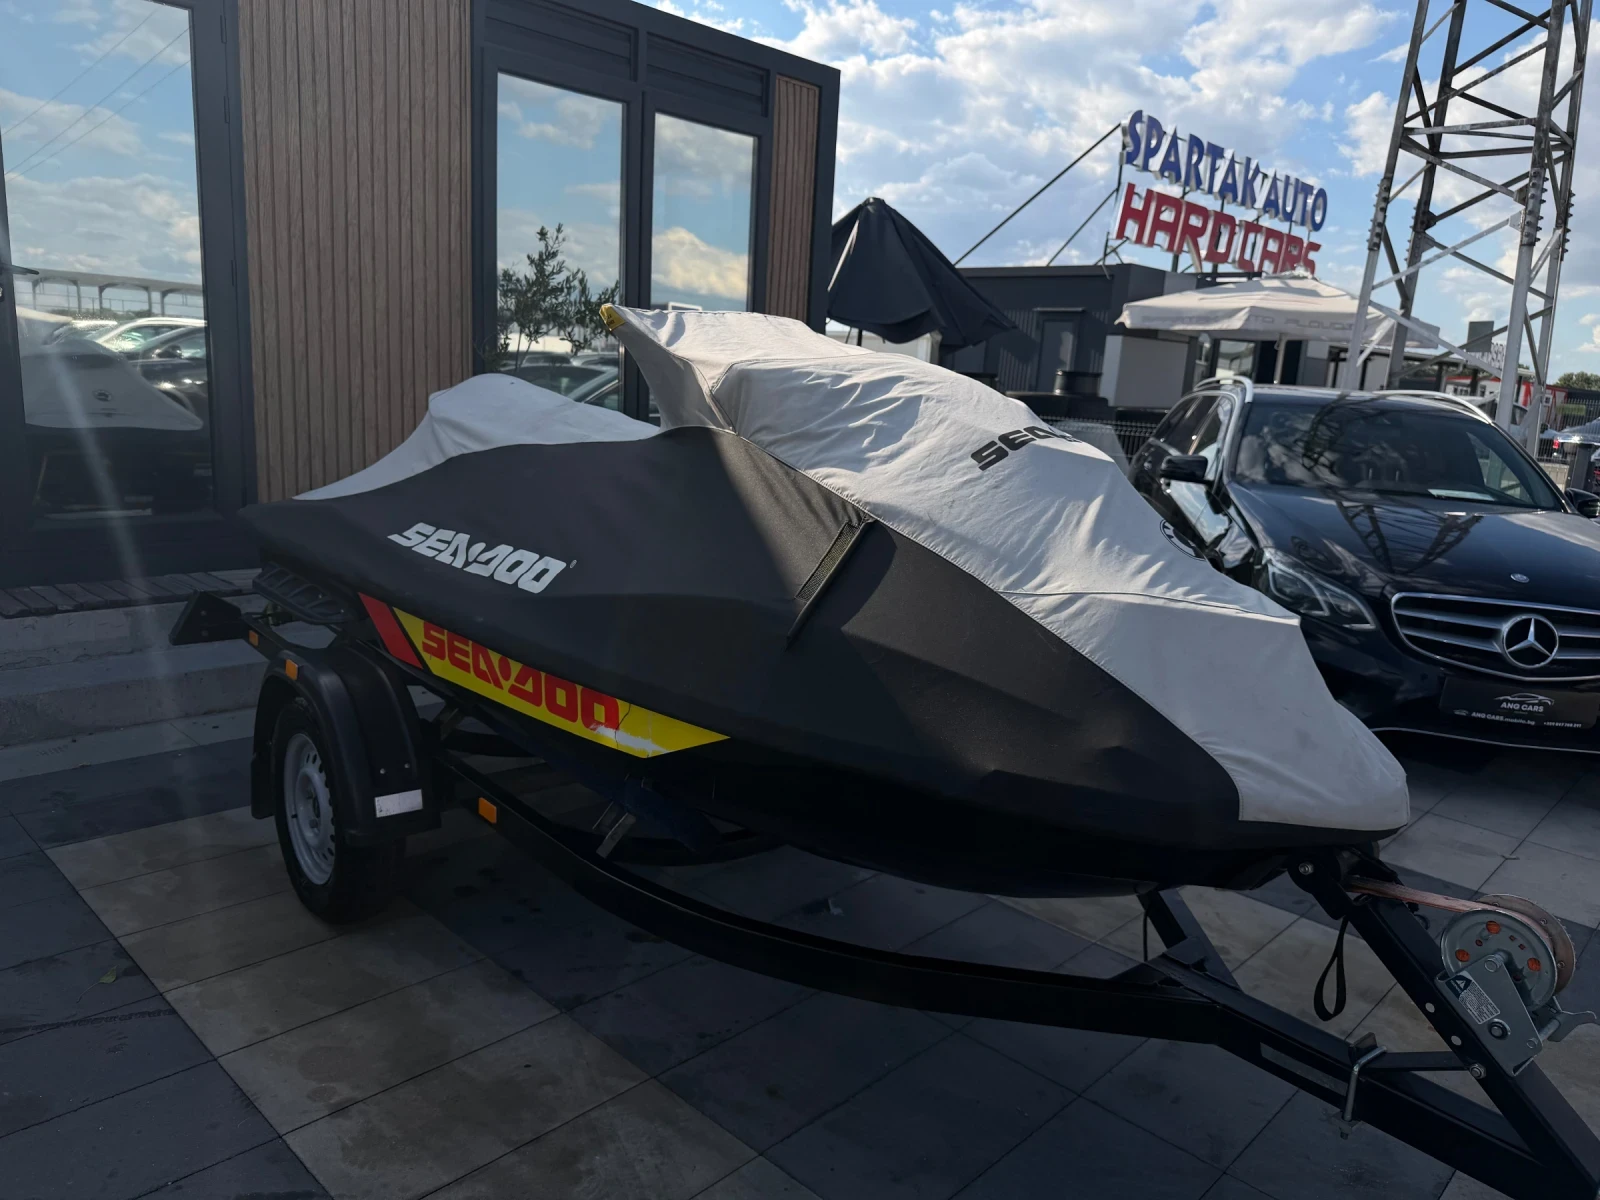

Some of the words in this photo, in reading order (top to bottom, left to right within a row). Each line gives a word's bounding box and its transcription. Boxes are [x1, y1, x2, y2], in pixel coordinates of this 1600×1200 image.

[1121, 110, 1260, 209] SPARTAK
[1259, 168, 1328, 232] AUTO
[1116, 182, 1237, 271] HARD
[1237, 220, 1322, 275] CARS
[1521, 704, 1544, 713] CARS
